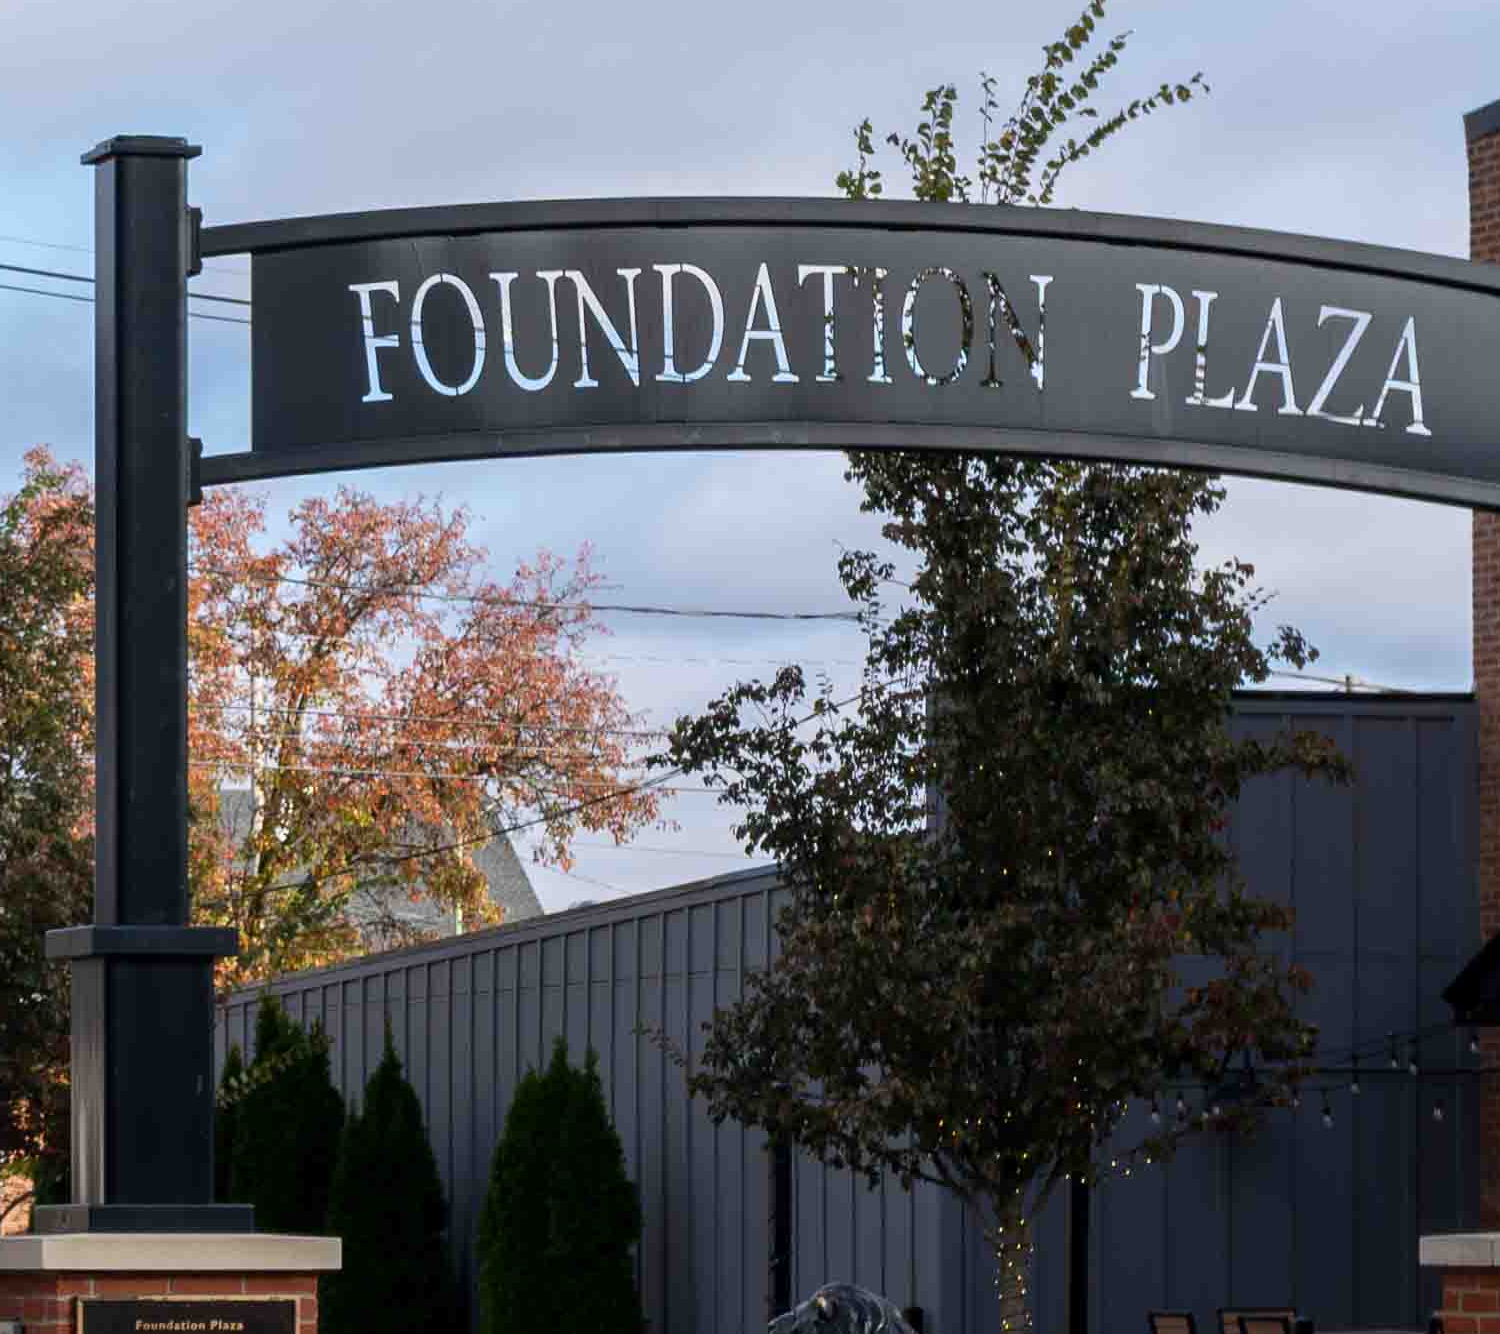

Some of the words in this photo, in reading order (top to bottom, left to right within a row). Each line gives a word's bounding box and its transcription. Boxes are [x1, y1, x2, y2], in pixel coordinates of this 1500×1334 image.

[348, 261, 1054, 403] FOUNDATION
[1129, 282, 1432, 437] PLAZA
[135, 1319, 206, 1331] Foundation
[209, 1319, 245, 1331] Plaza
